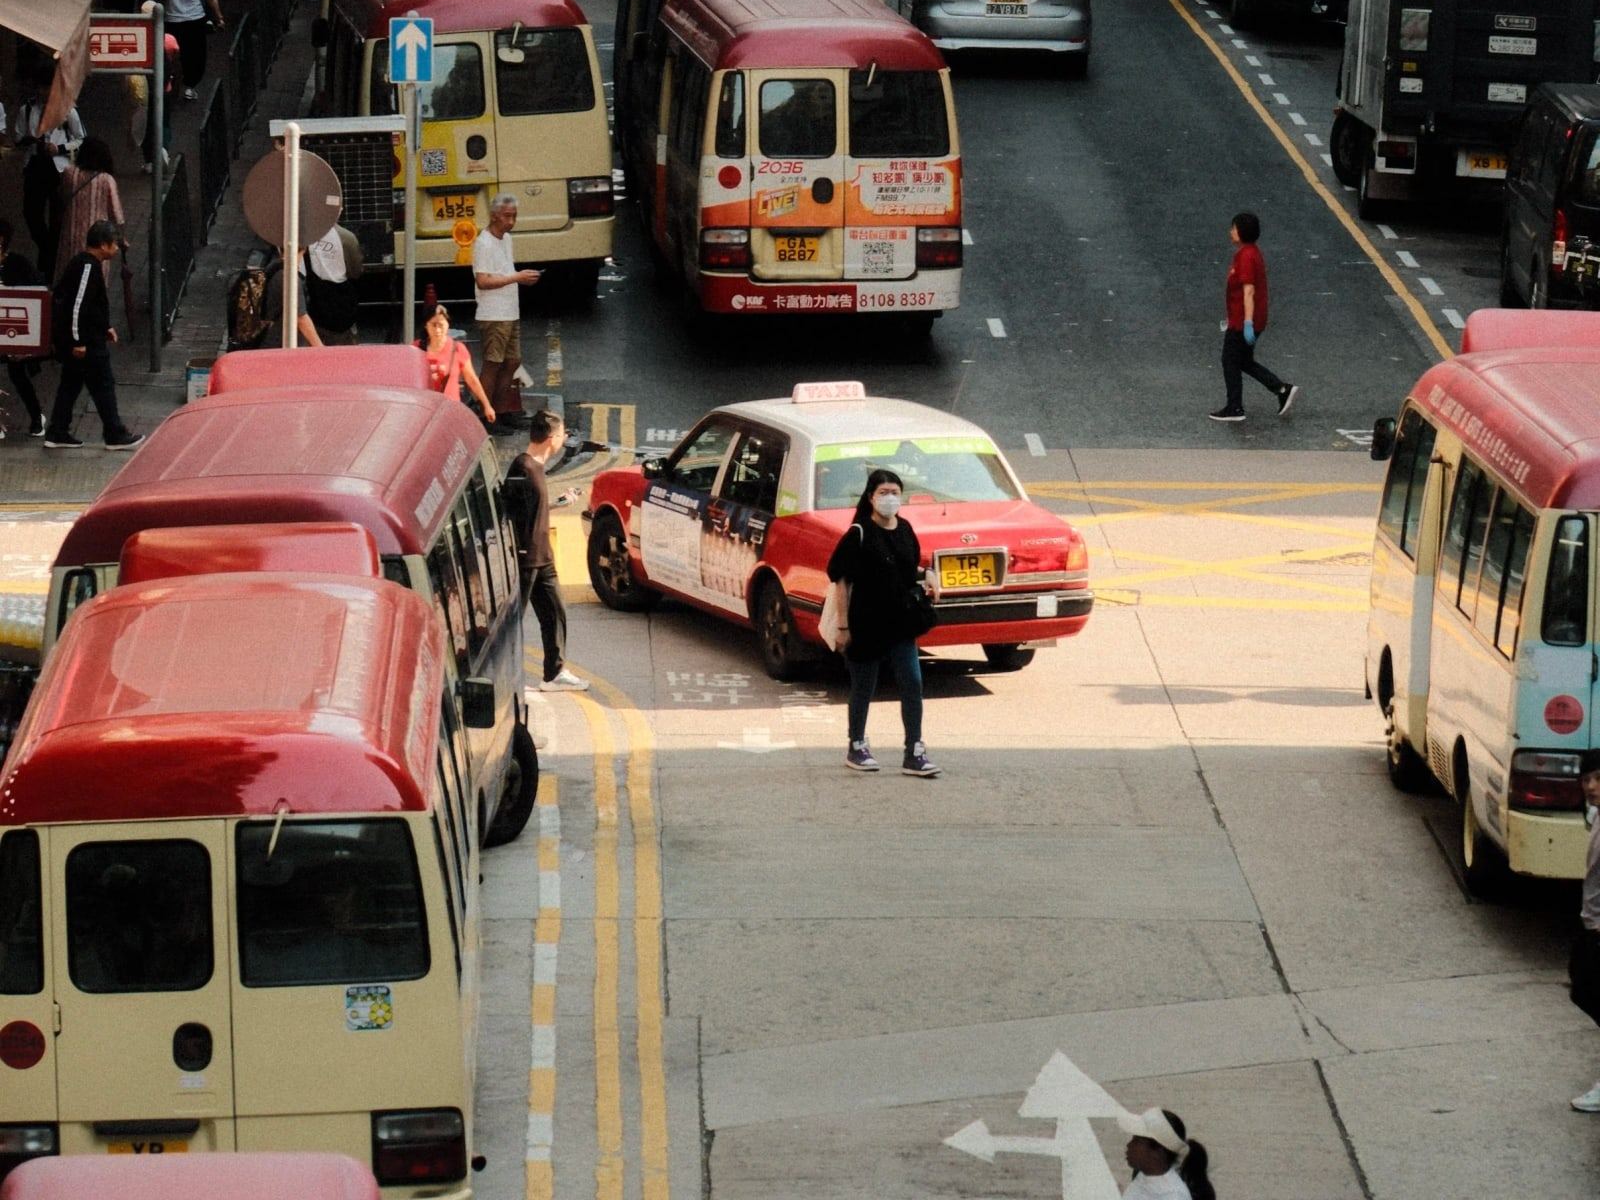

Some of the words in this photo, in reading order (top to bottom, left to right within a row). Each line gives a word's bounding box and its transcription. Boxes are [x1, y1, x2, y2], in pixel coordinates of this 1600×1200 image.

[436, 206, 476, 218] 4925
[787, 238, 806, 250] GA
[778, 249, 816, 261] 8287
[859, 294, 896, 307] 8108
[900, 292, 936, 306] 8387
[804, 384, 859, 398] TAXI
[956, 555, 979, 571] TR
[945, 569, 992, 586] 5256
